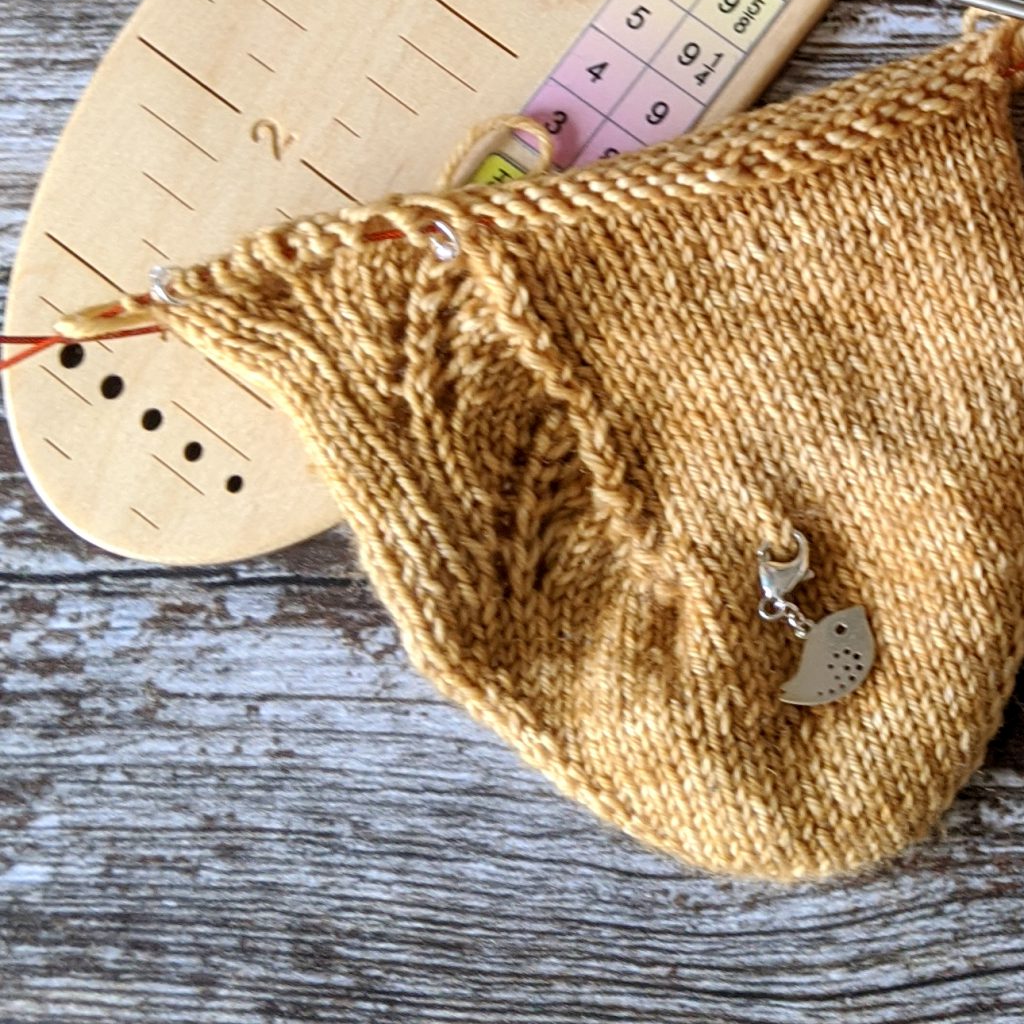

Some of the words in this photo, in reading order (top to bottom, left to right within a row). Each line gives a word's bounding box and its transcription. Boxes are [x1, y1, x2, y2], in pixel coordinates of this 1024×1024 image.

[626, 6, 651, 29] 5
[586, 61, 609, 84] 4
[645, 101, 670, 125] 9
[250, 118, 298, 161] 2
[544, 110, 568, 135] 3
